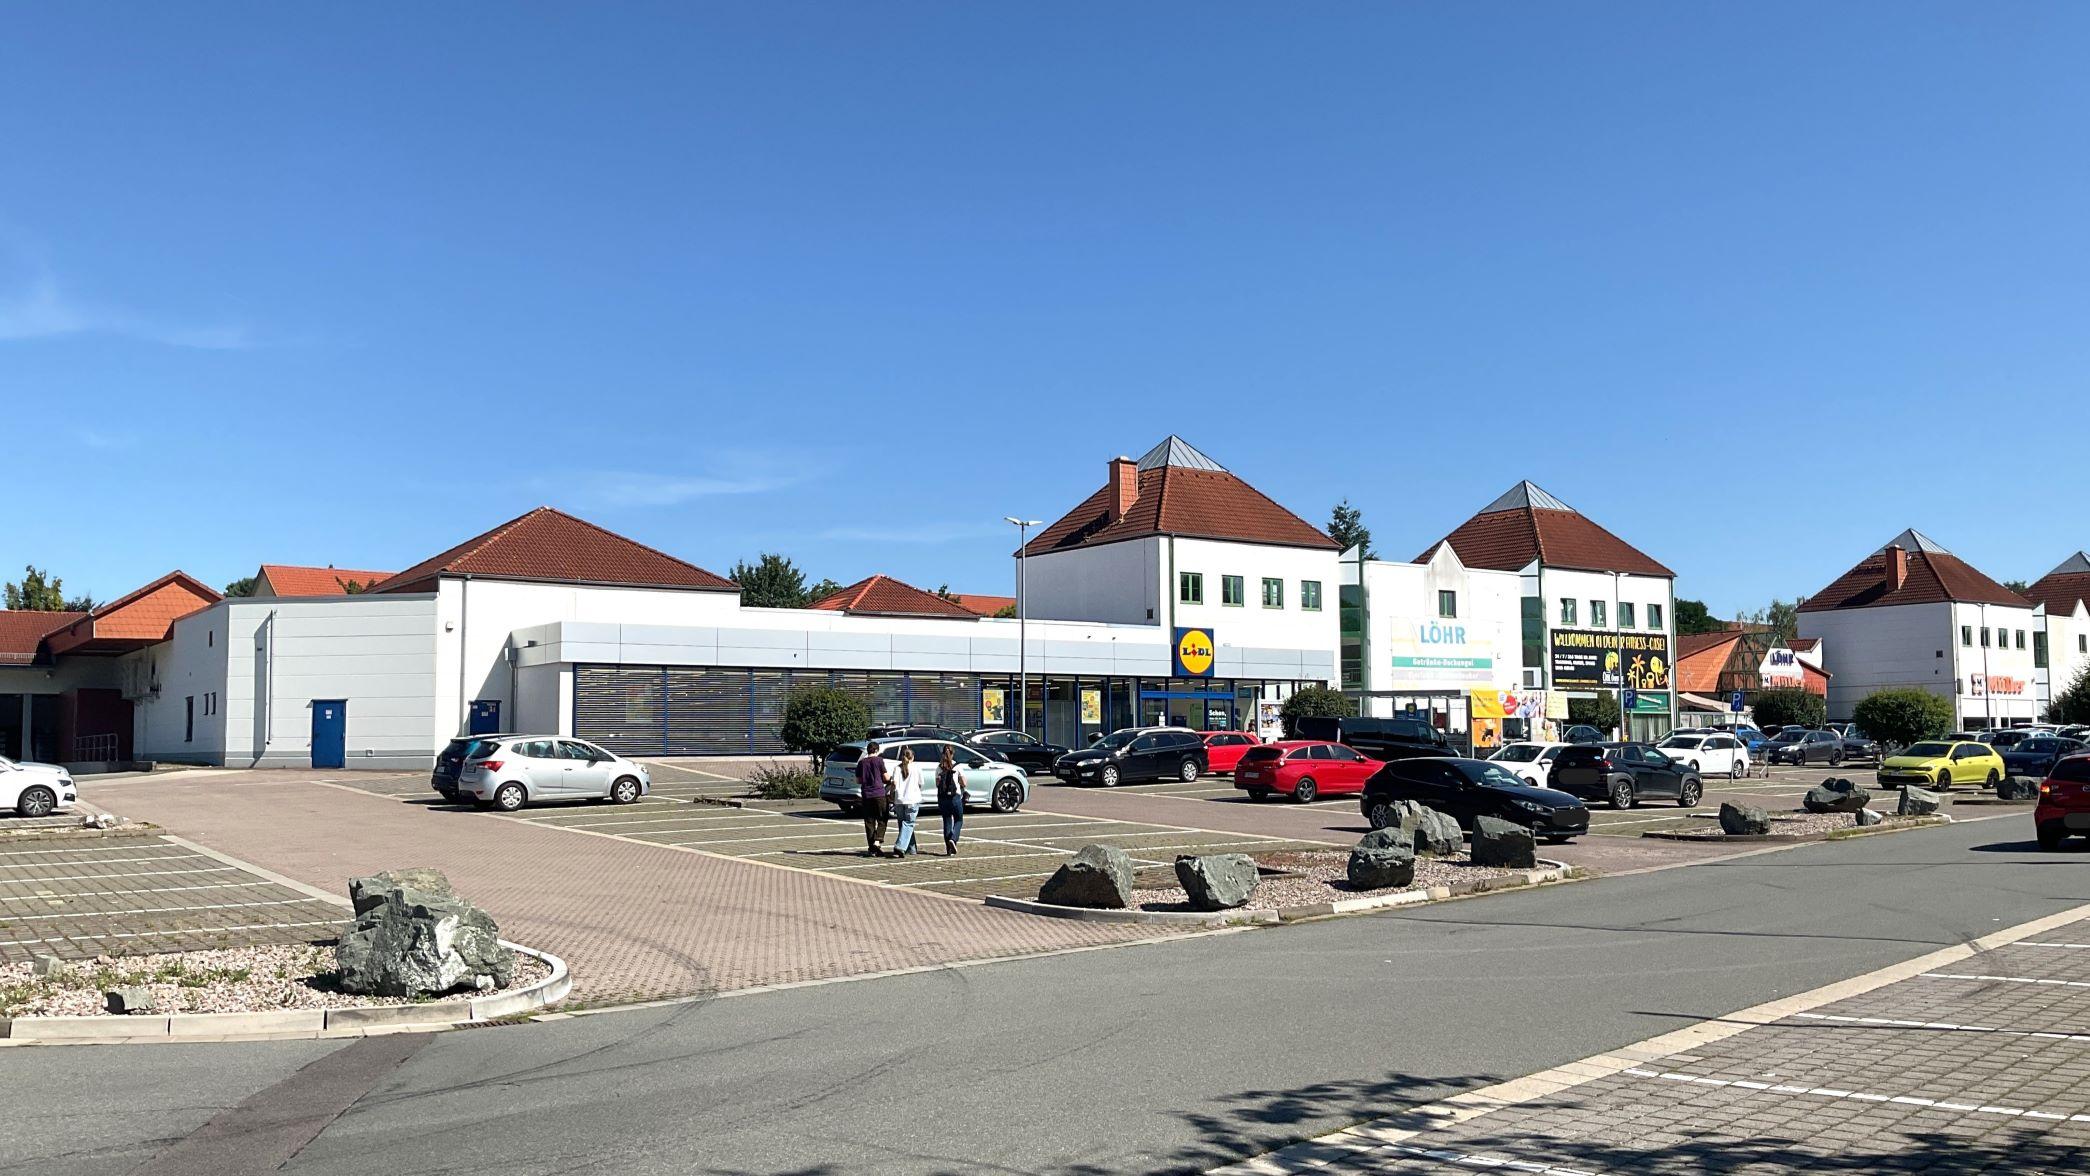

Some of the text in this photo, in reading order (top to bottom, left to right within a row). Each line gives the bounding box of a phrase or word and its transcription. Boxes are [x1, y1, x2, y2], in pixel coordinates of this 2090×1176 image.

[1420, 621, 1466, 645] LÖHR
[1603, 635, 1625, 650] DEINR
[1770, 650, 1794, 665] LÖHR
[1625, 691, 1633, 703] P
[1732, 693, 1741, 705] P
